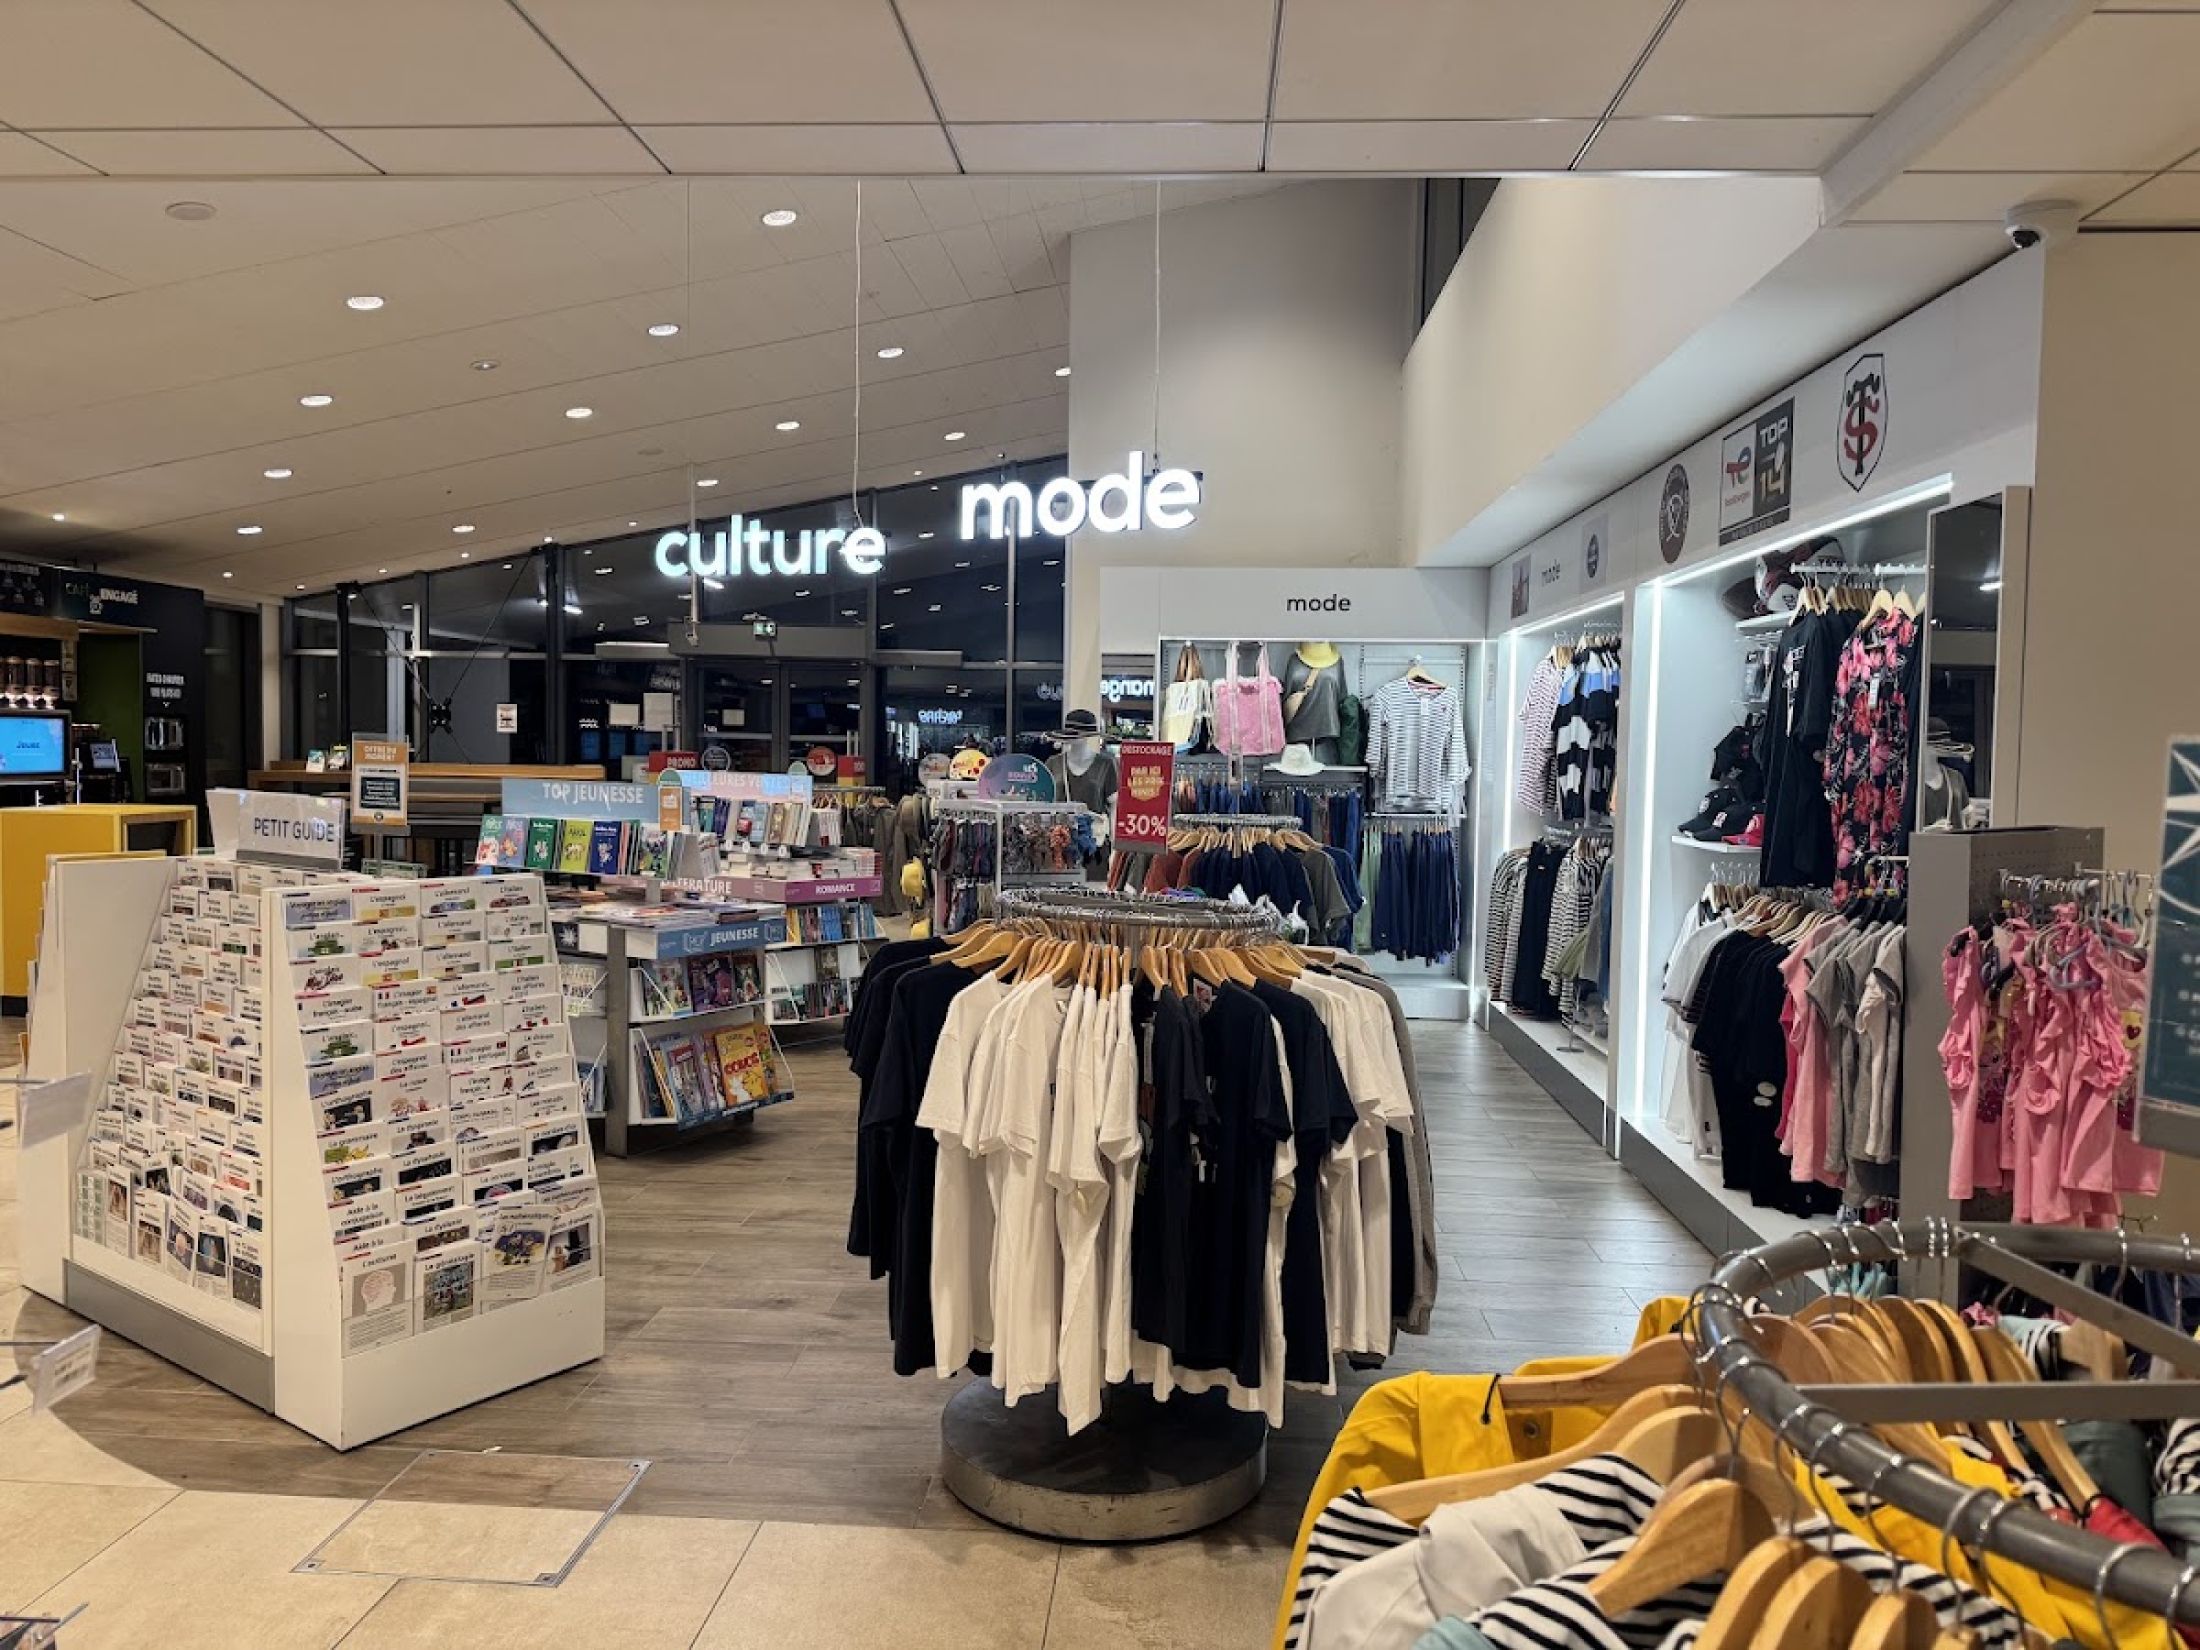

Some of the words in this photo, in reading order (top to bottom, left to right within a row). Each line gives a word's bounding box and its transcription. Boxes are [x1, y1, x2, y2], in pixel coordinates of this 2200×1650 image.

[1760, 417, 1788, 448] TOP
[1760, 462, 1785, 498] 14
[961, 450, 1200, 539] mode
[655, 514, 887, 576] culture
[1287, 593, 1351, 611] mode
[667, 756, 696, 768] PROMO
[542, 782, 571, 804] TOP
[572, 784, 645, 811] JEUNESSE
[254, 817, 290, 838] PETIT
[293, 820, 334, 842] GUIDE
[1118, 813, 1167, 837] -30%
[815, 883, 856, 895] ROMANCE
[709, 927, 759, 946] JEUNESSE
